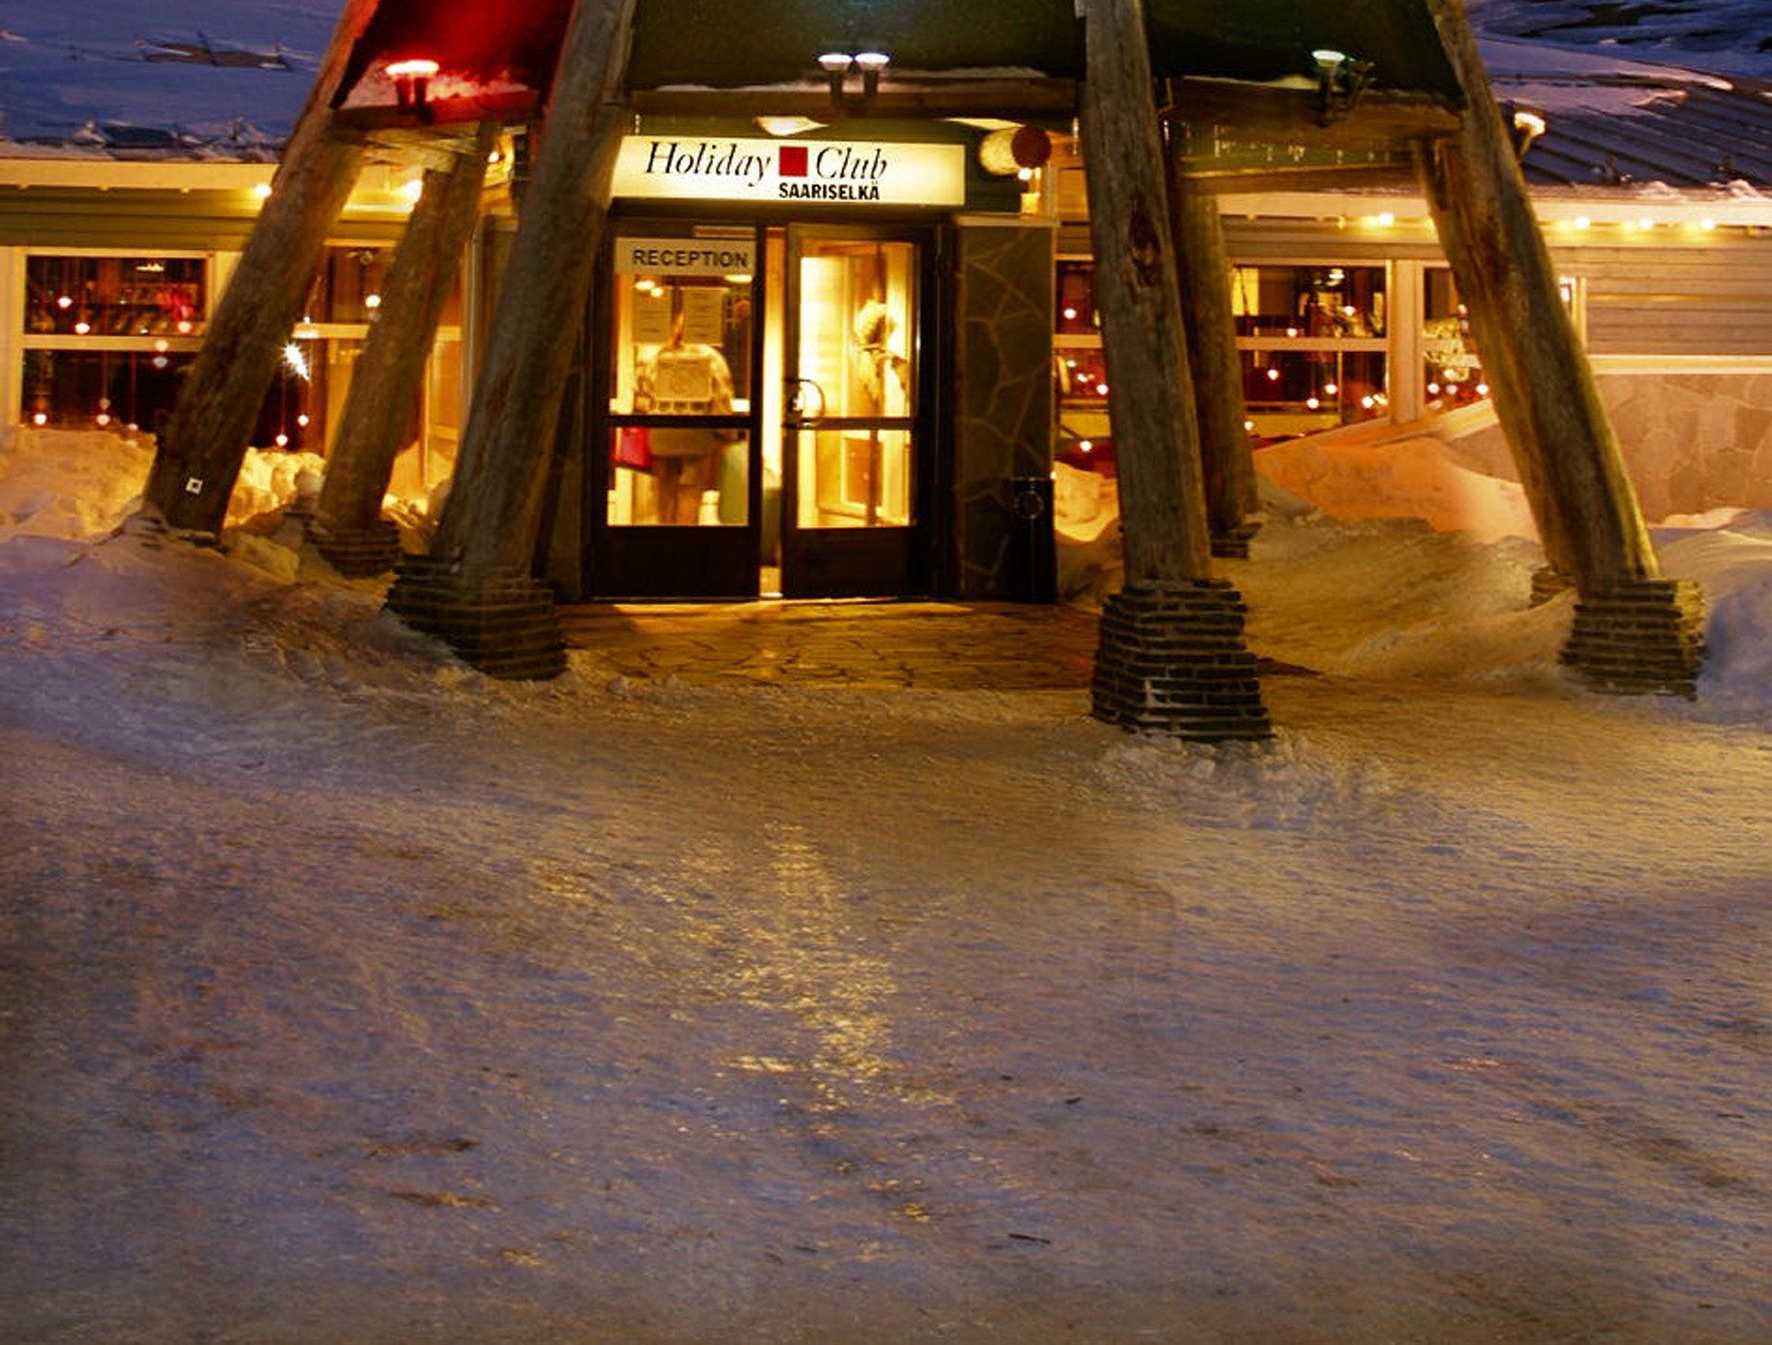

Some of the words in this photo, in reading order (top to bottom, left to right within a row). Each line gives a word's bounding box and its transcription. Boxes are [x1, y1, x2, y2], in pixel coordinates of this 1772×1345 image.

[645, 140, 771, 187] Holiday
[816, 146, 887, 180] Club
[778, 181, 881, 201] SAARISELKÄ
[633, 249, 748, 269] RECEPTION
